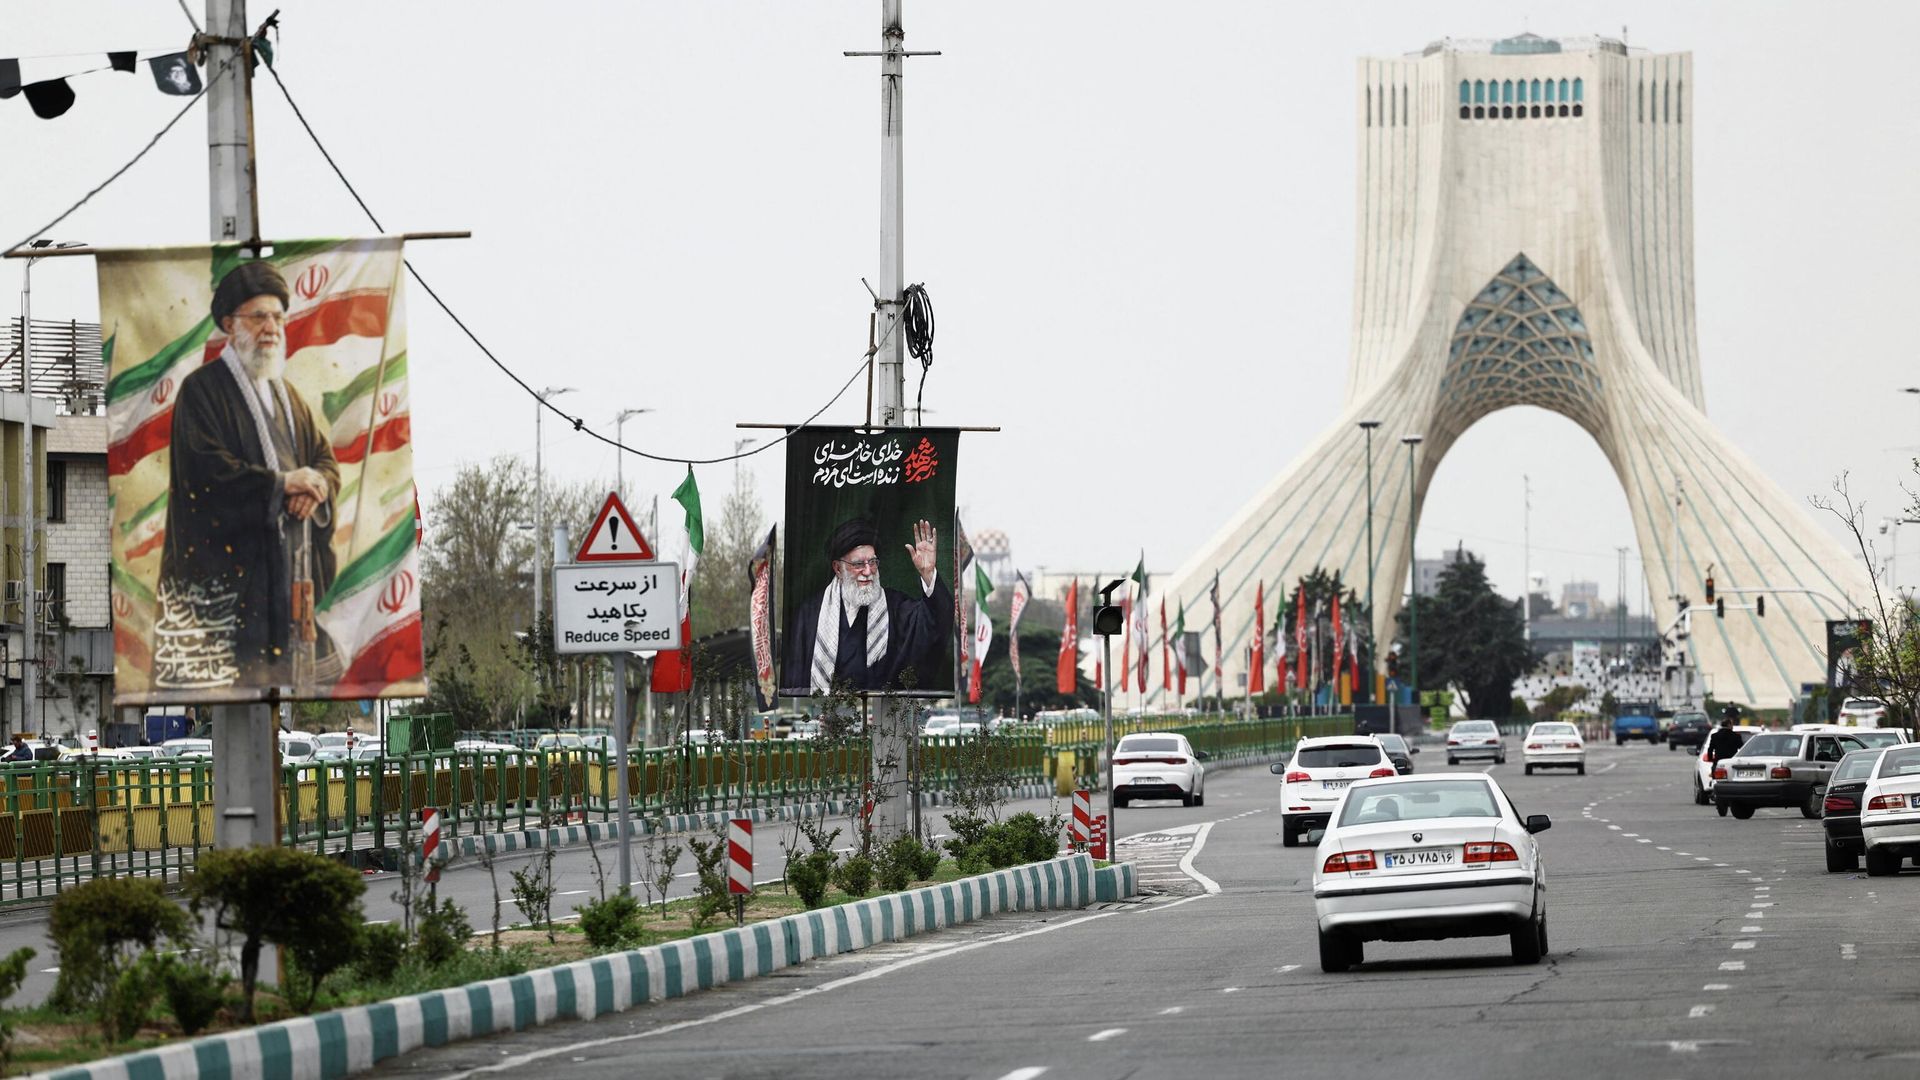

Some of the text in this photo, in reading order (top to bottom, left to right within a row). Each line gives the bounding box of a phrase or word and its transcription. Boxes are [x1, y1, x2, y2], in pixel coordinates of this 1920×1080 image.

[877, 467, 901, 486] زنده
[574, 574, 657, 596] از سرعت
[586, 603, 647, 623] بکاهید
[565, 628, 670, 643] Reduce Speed
[1418, 852, 1438, 863] ۷۸۵
[1441, 853, 1453, 863] ۱۶
